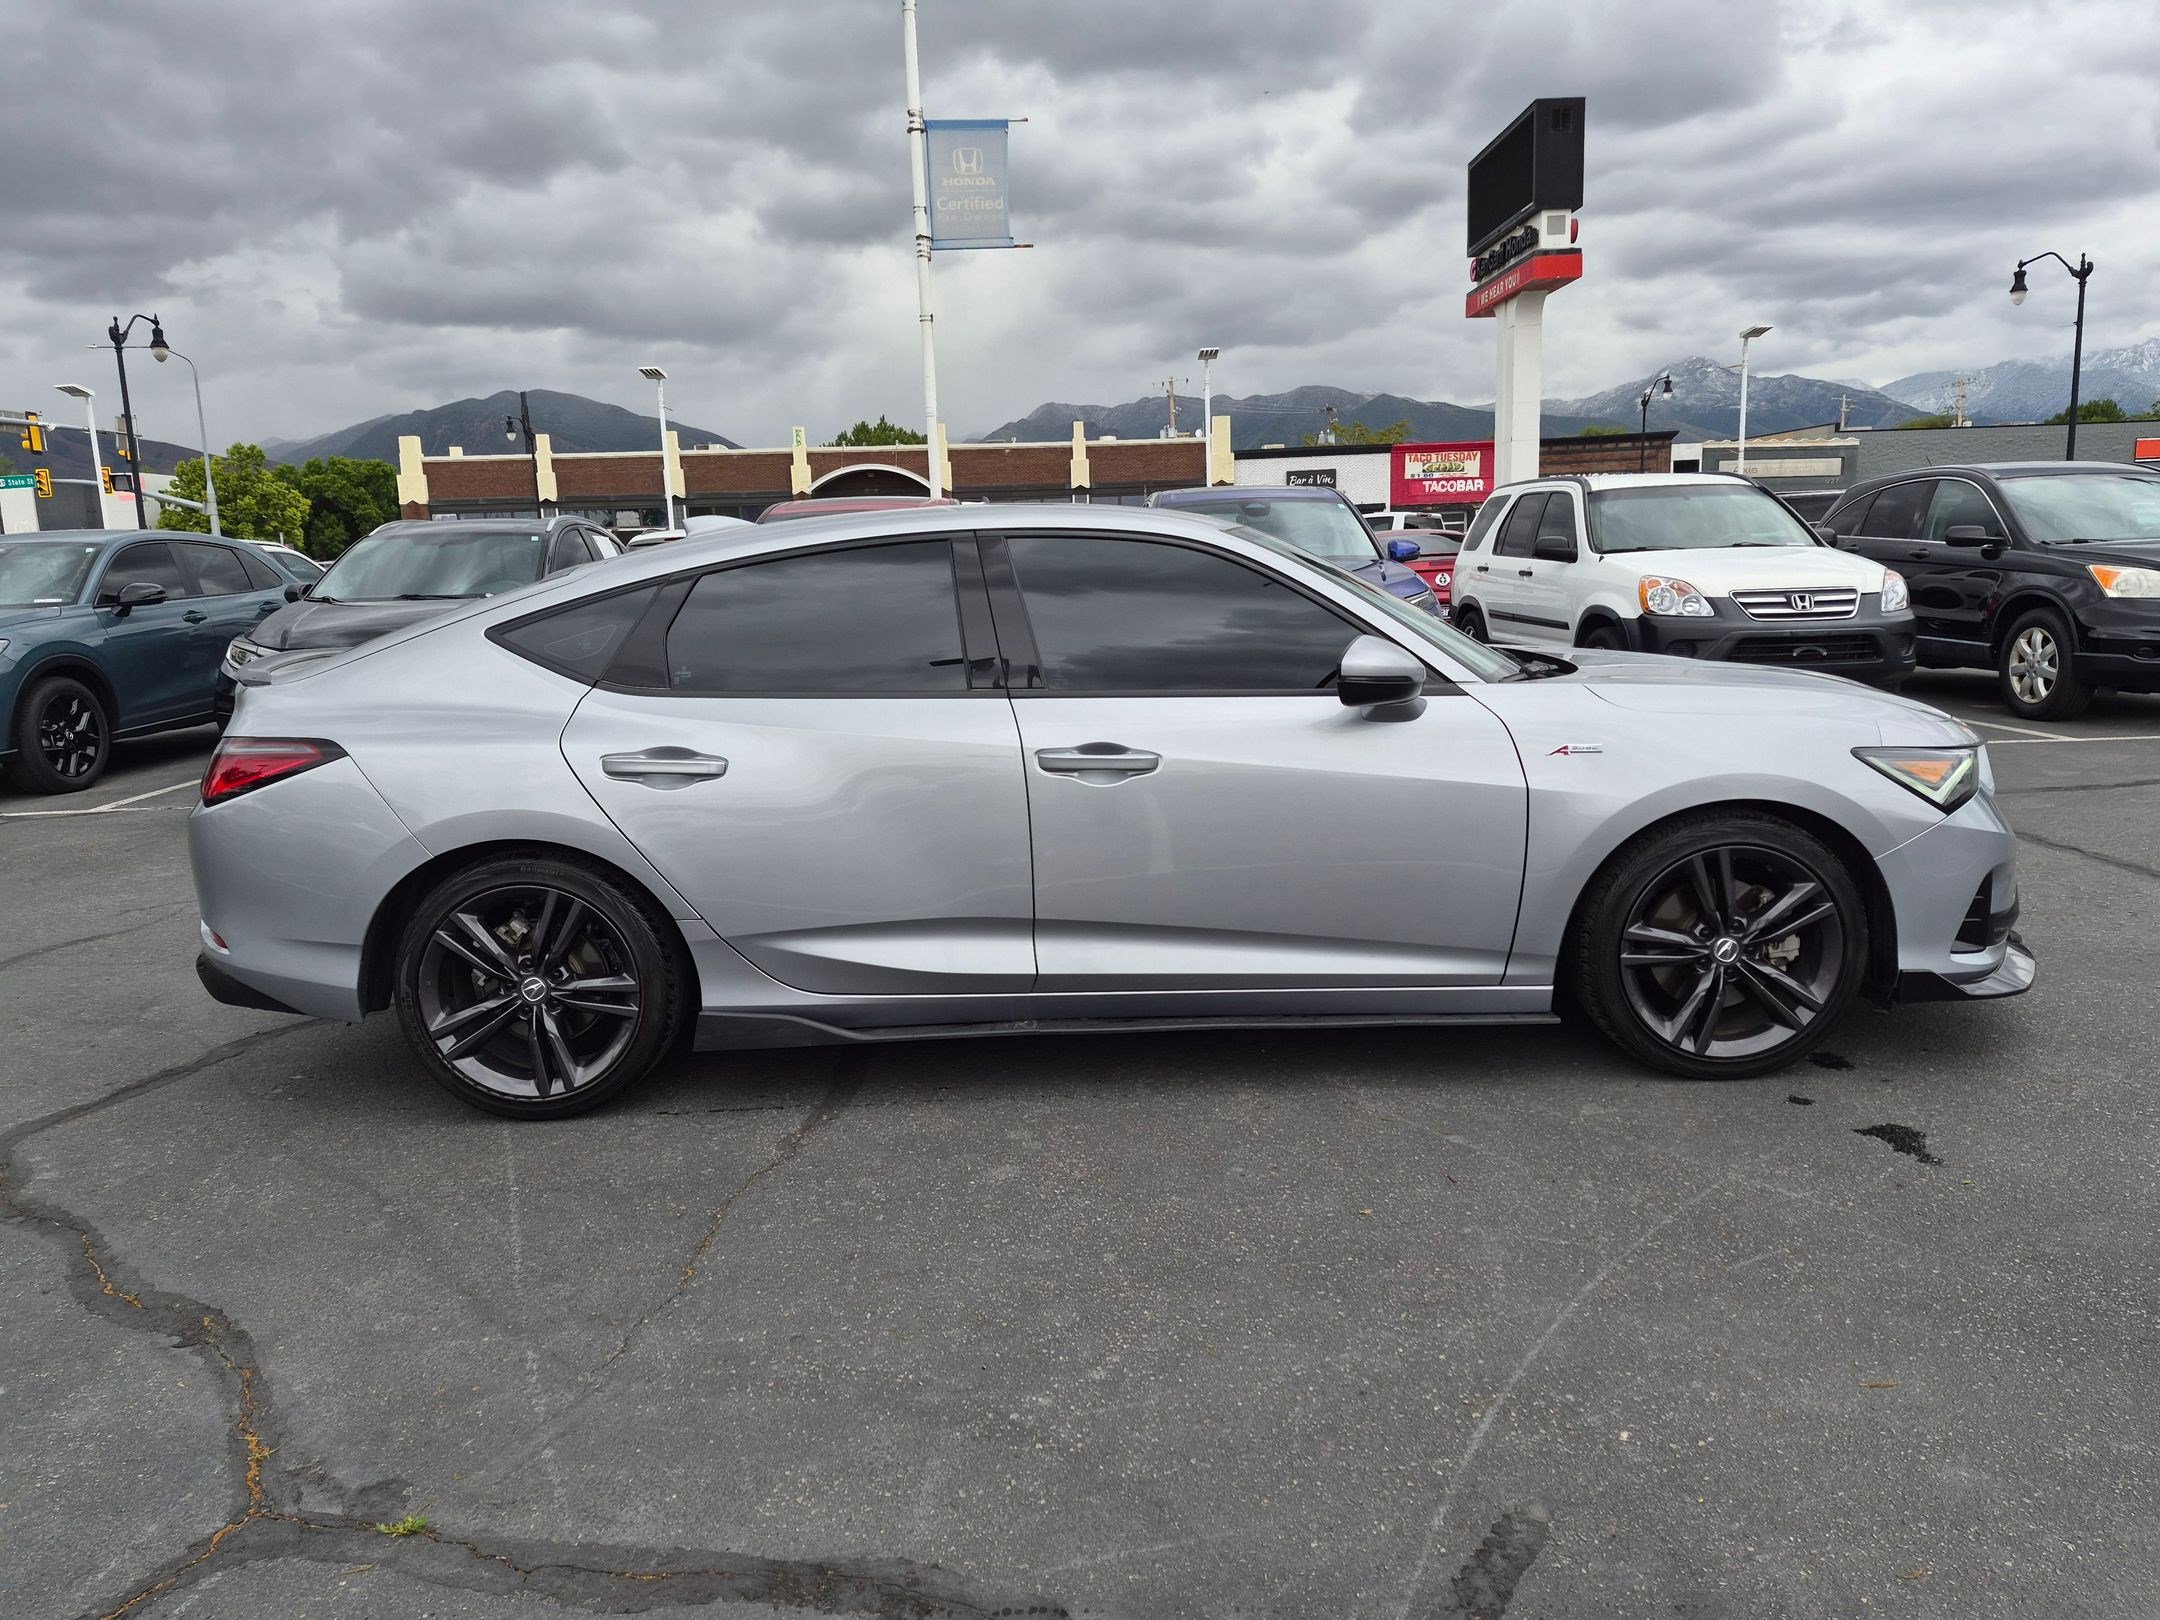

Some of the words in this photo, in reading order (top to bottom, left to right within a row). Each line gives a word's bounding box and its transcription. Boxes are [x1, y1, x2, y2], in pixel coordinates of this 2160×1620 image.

[944, 177, 995, 186] HONDA
[937, 195, 1004, 210] Certified
[1489, 281, 1504, 300] HEAR
[1407, 453, 1432, 463] TACO
[1434, 451, 1479, 462] TUESDAY
[1289, 475, 1307, 486] Bar
[1316, 474, 1334, 484] Vin
[1422, 479, 1484, 492] TACOBAR
